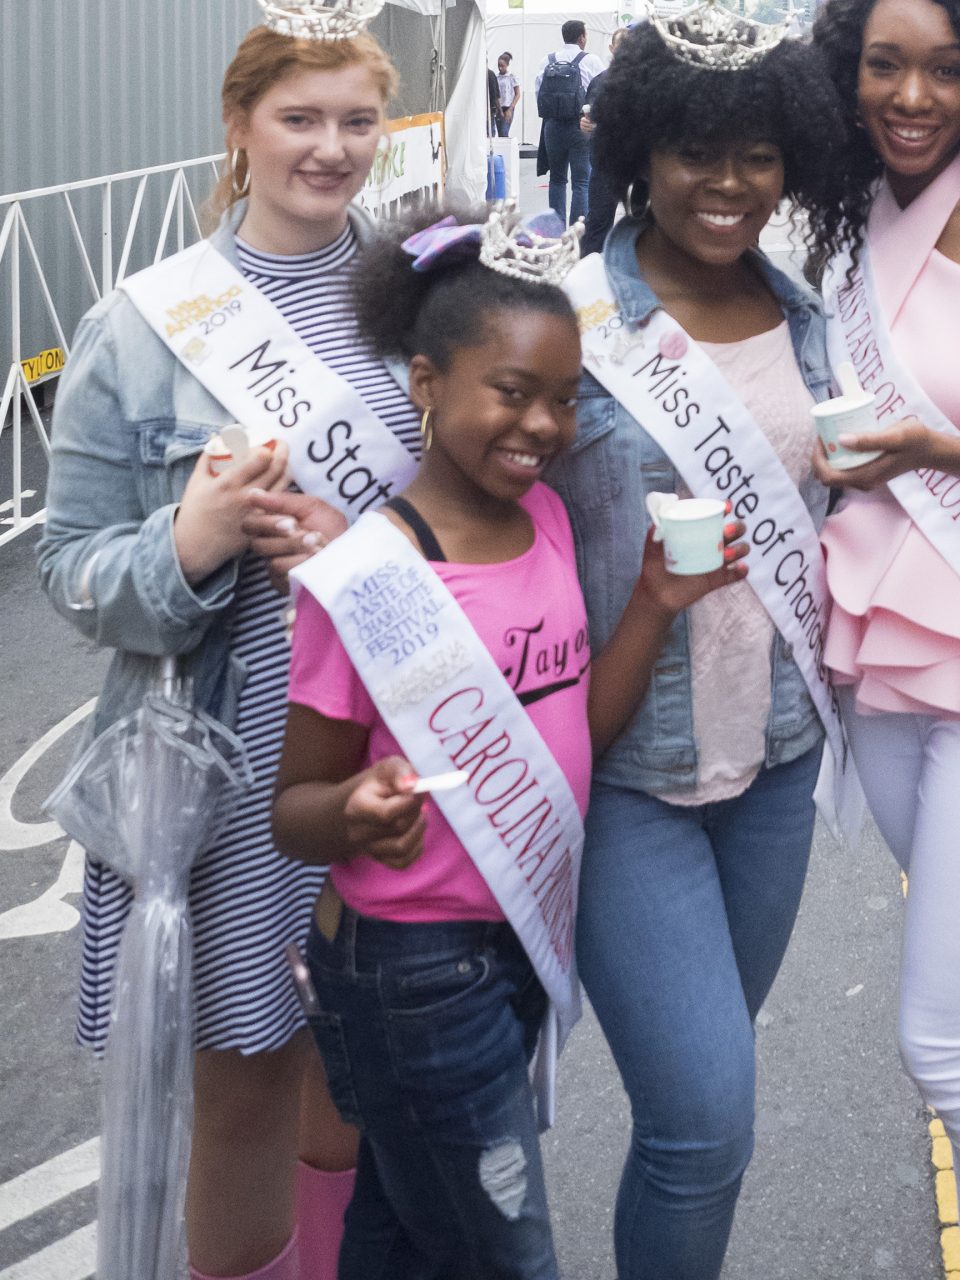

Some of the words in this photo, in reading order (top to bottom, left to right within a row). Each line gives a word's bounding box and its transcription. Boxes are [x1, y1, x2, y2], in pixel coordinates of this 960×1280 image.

[199, 299, 241, 335] 2019
[836, 268, 867, 323] MISS
[597, 316, 624, 339] 20
[845, 312, 884, 391] TASTE
[229, 339, 311, 428] Miss
[308, 420, 393, 515] Stat
[874, 381, 906, 421] OF
[632, 352, 701, 428] Miss
[694, 415, 759, 520] Taste
[752, 518, 795, 558] of
[347, 583, 400, 626] TASTE
[399, 565, 419, 589] OF
[350, 560, 400, 600] MISS
[358, 579, 433, 642] CHARLOTTE
[366, 597, 446, 658] FESTIVAL
[390, 622, 439, 666] 2019
[428, 686, 563, 883] CAROLINA
